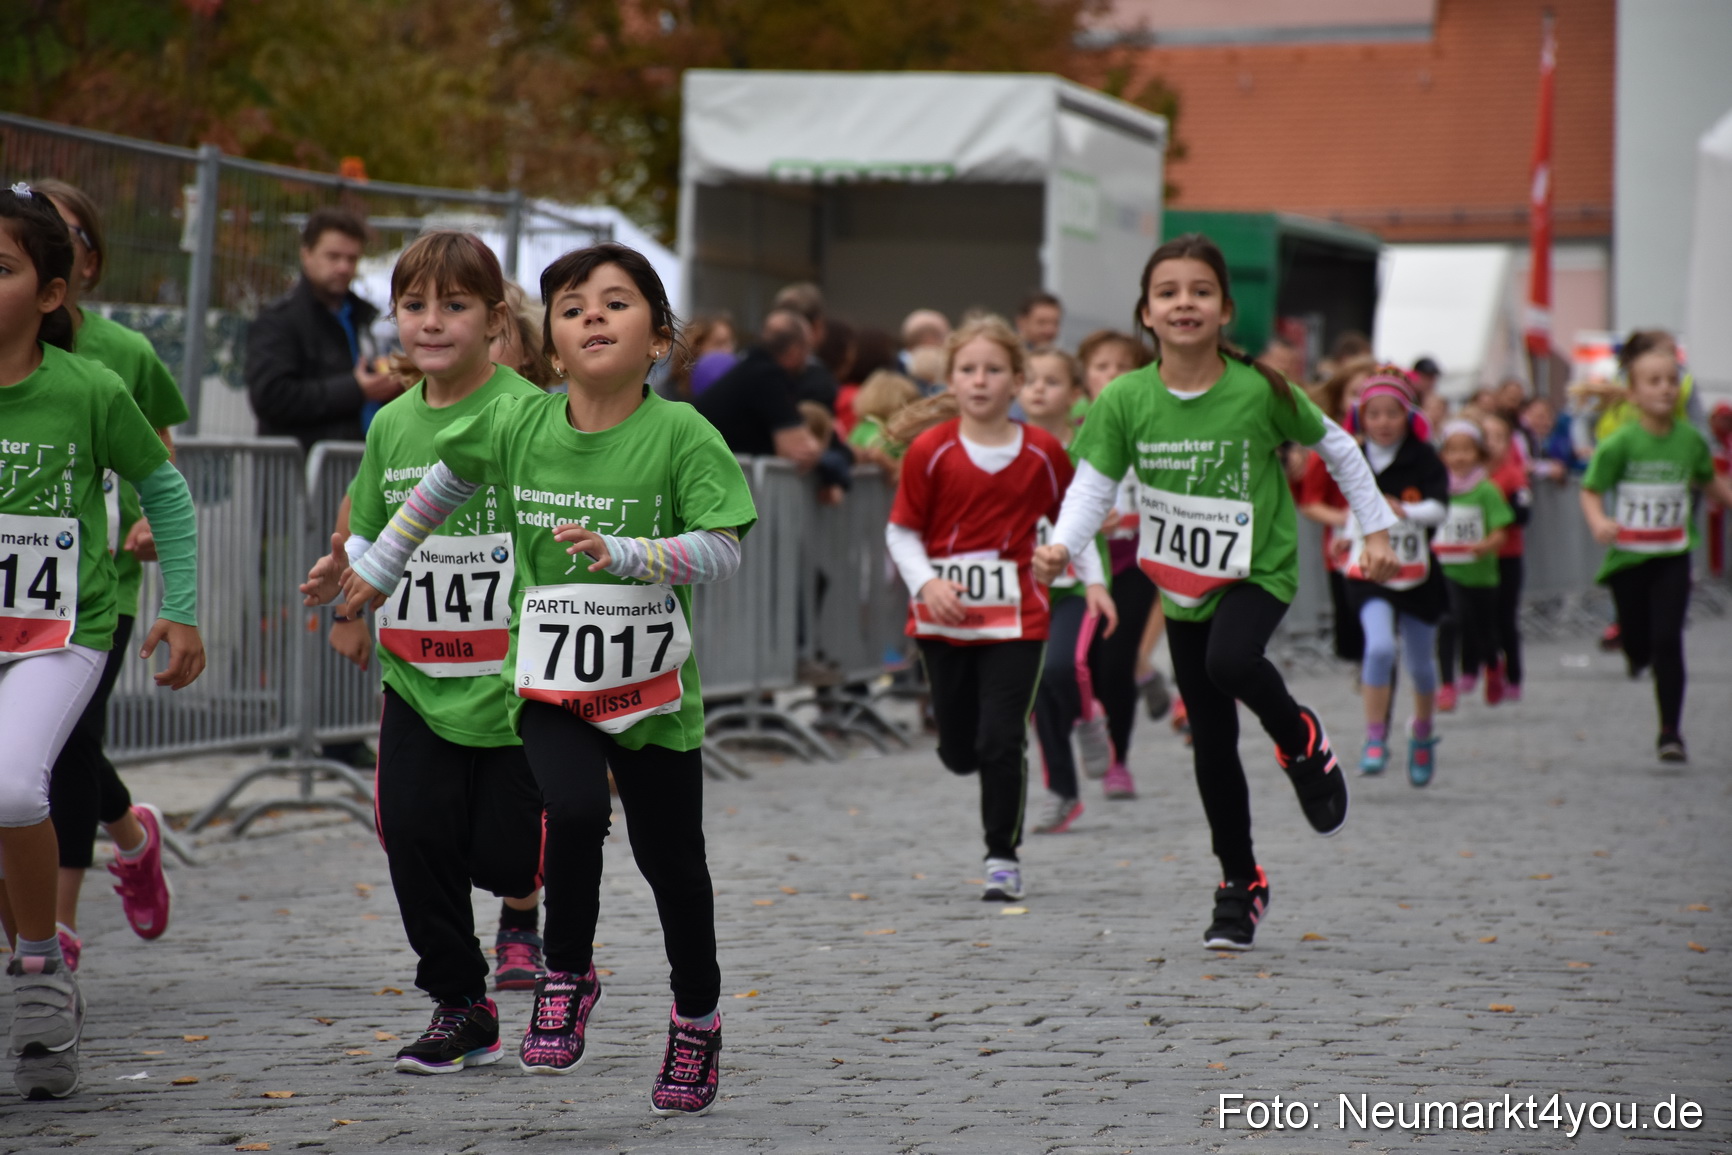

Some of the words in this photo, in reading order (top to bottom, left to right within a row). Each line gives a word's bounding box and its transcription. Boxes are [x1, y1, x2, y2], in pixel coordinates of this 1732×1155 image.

[513, 485, 614, 510] Neumarkter
[1141, 495, 1171, 514] PARTL
[1173, 506, 1230, 523] Neumarkt
[516, 510, 590, 530] tadtlauf
[1149, 515, 1239, 571] 7407
[420, 550, 485, 564] Neumarkt
[397, 571, 500, 622] 7147
[526, 599, 580, 615] PARTL
[584, 601, 663, 616] Neumarkt
[421, 638, 474, 657] Paula
[539, 622, 674, 683] 7017
[562, 689, 642, 718] Melissa
